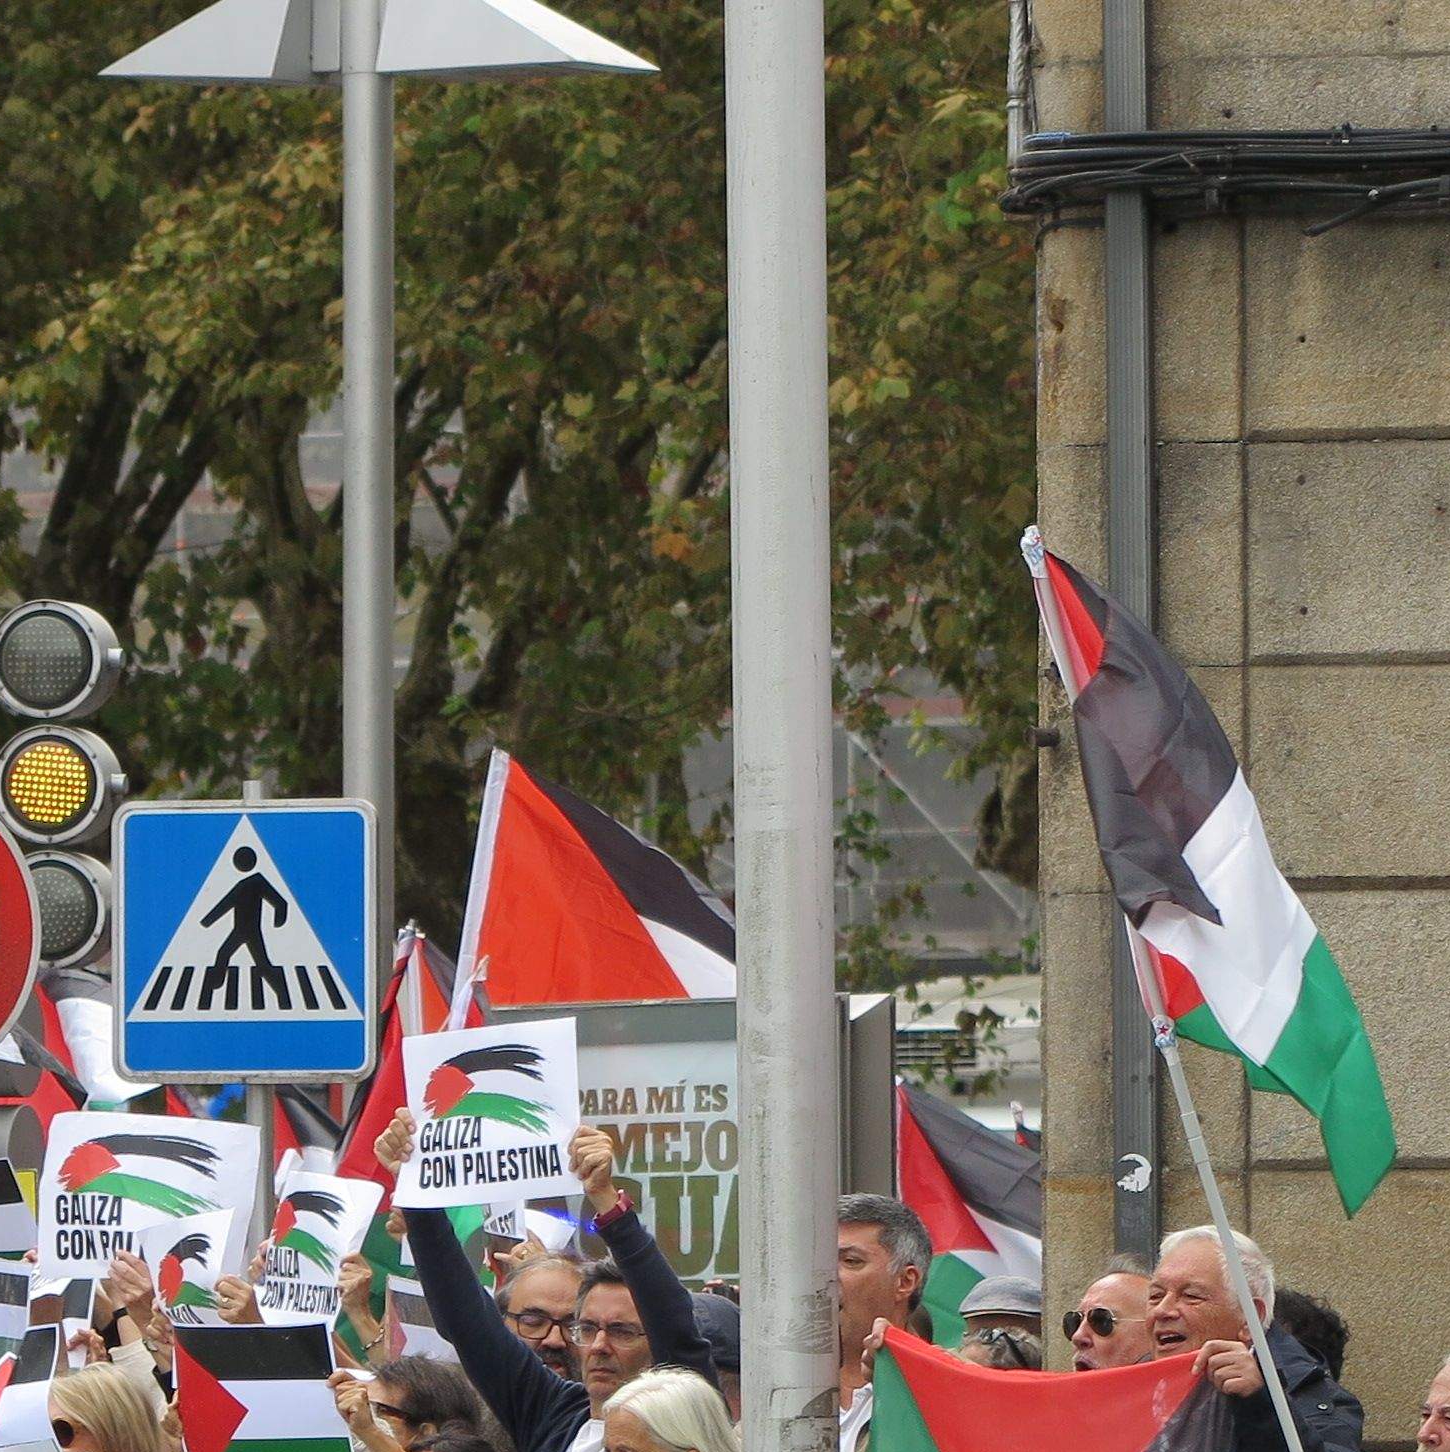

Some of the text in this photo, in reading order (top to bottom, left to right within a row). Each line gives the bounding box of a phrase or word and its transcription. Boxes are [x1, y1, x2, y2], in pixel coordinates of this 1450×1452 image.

[645, 1078, 686, 1114] MÍ
[693, 1085, 728, 1113] ES
[420, 1117, 482, 1153] GALIZA
[599, 1120, 740, 1174] MEJO
[419, 1143, 563, 1190] CON PALESTINA
[55, 1194, 123, 1226] GALIZA
[56, 1229, 97, 1260] CON
[265, 1249, 300, 1279] GALIZA
